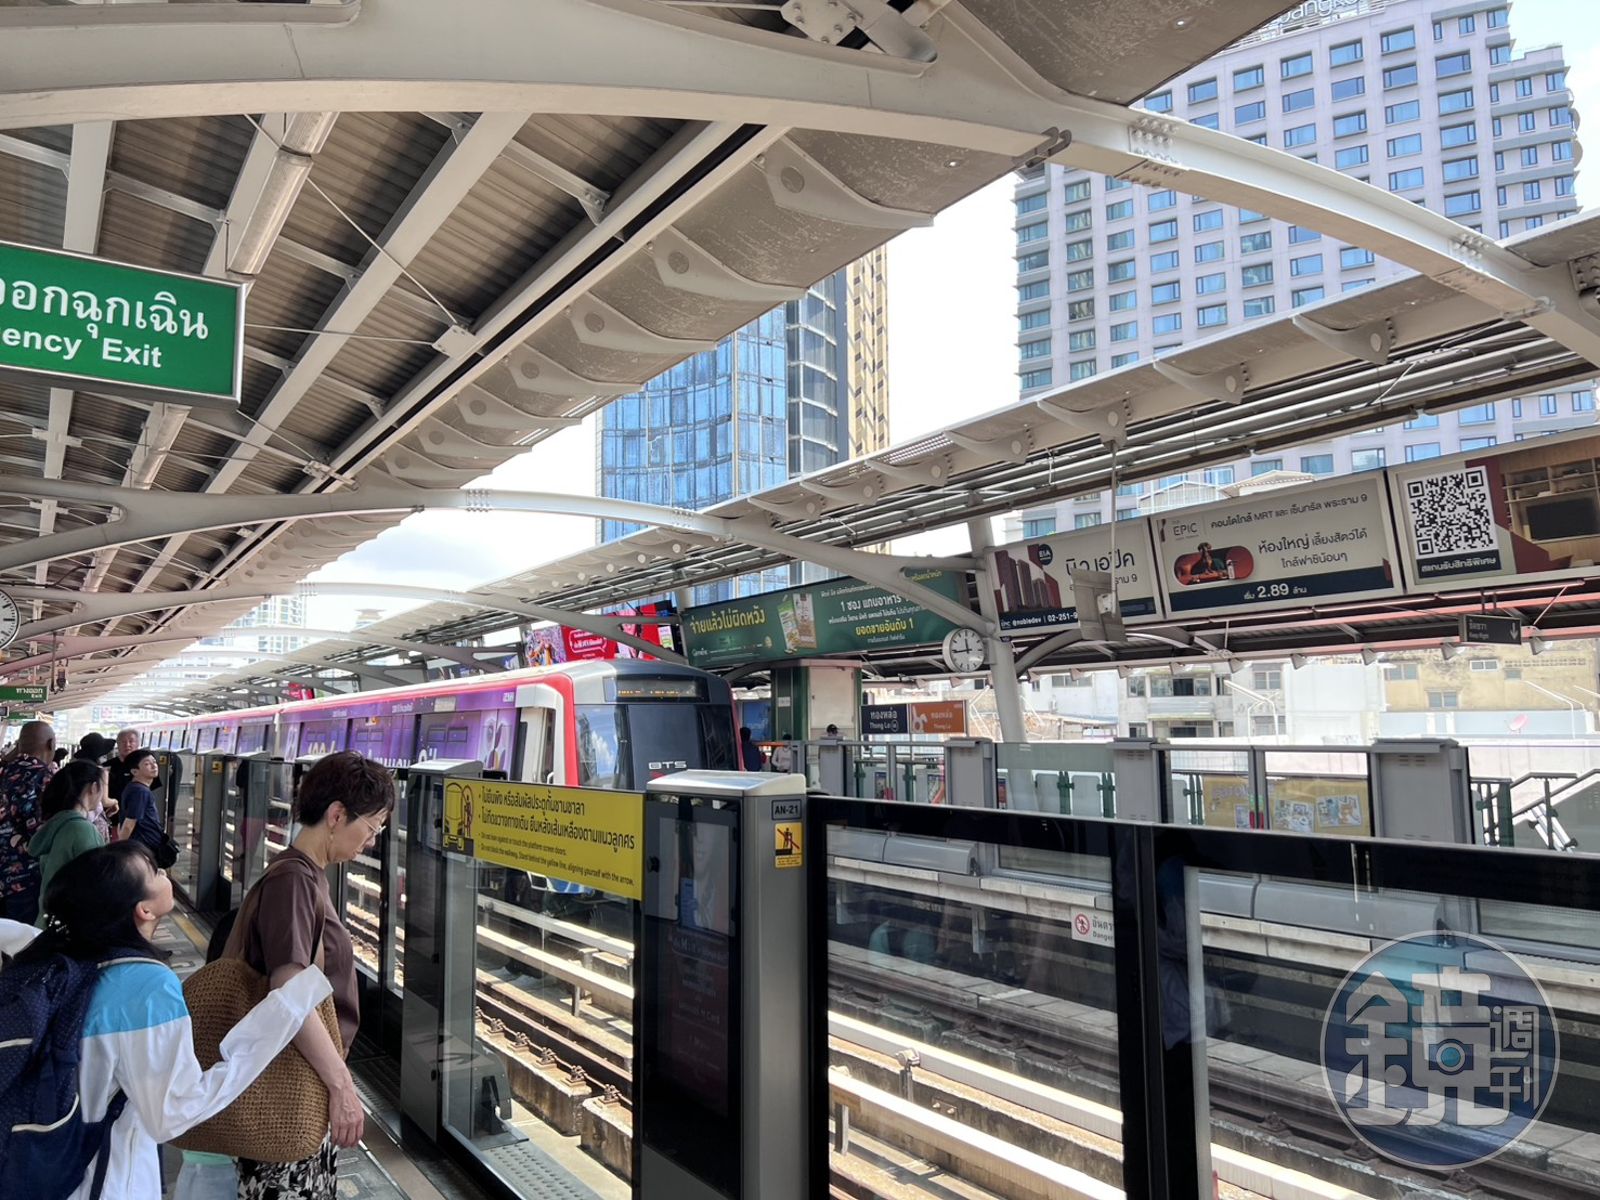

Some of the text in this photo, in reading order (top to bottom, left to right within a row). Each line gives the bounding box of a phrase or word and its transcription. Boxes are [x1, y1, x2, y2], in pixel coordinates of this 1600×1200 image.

[1, 326, 163, 369] ency Exit
[1253, 510, 1274, 522] MRT
[1323, 495, 1360, 508] พระราม
[1360, 493, 1368, 503] 9
[1173, 522, 1198, 537] EPIC
[1257, 533, 1310, 555] ห้องใหญ่
[1257, 583, 1289, 598] 2.89
[690, 605, 766, 635] จ่ายแล้วไม่ผิดหวัง
[1047, 611, 1079, 623] 02-251-9
[648, 760, 688, 770] BTS
[774, 804, 799, 815] AN-21
